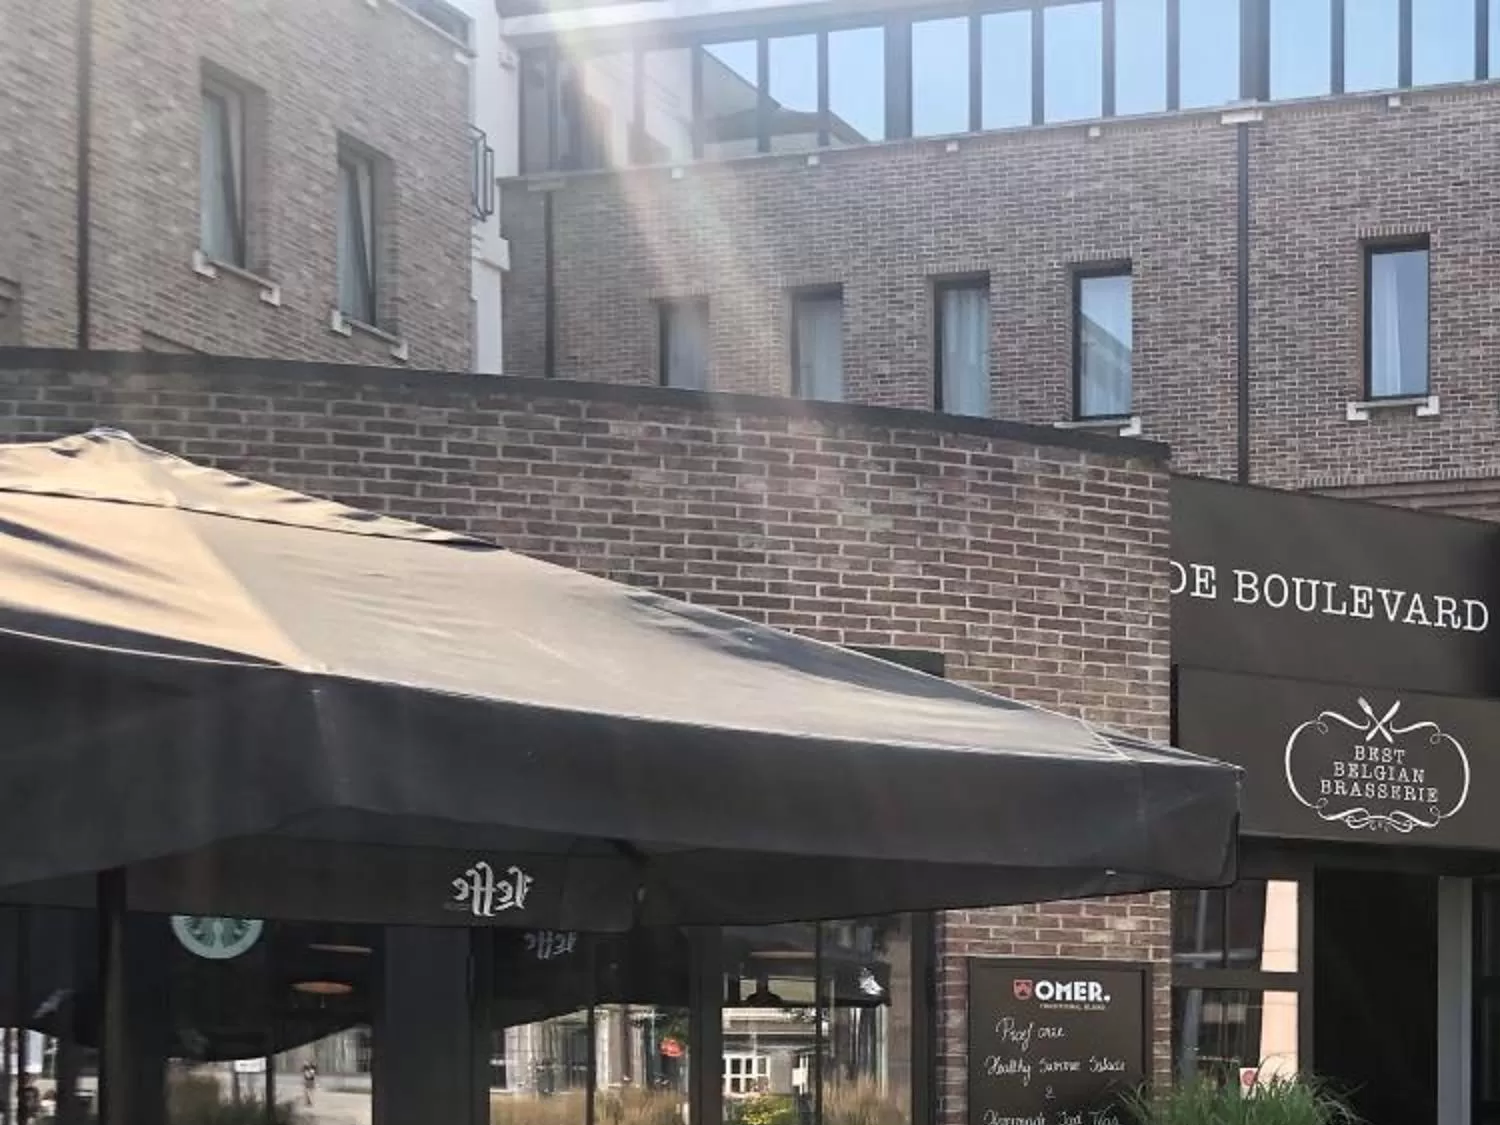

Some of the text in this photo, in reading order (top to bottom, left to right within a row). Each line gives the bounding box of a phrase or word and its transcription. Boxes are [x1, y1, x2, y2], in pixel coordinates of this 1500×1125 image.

[1170, 561, 1489, 632] DE BOULEVARD
[1354, 745, 1406, 764] BEST
[1333, 761, 1425, 783] BELGIAN
[1320, 779, 1439, 803] BRASSERIE
[1034, 980, 1111, 1002] OMER.
